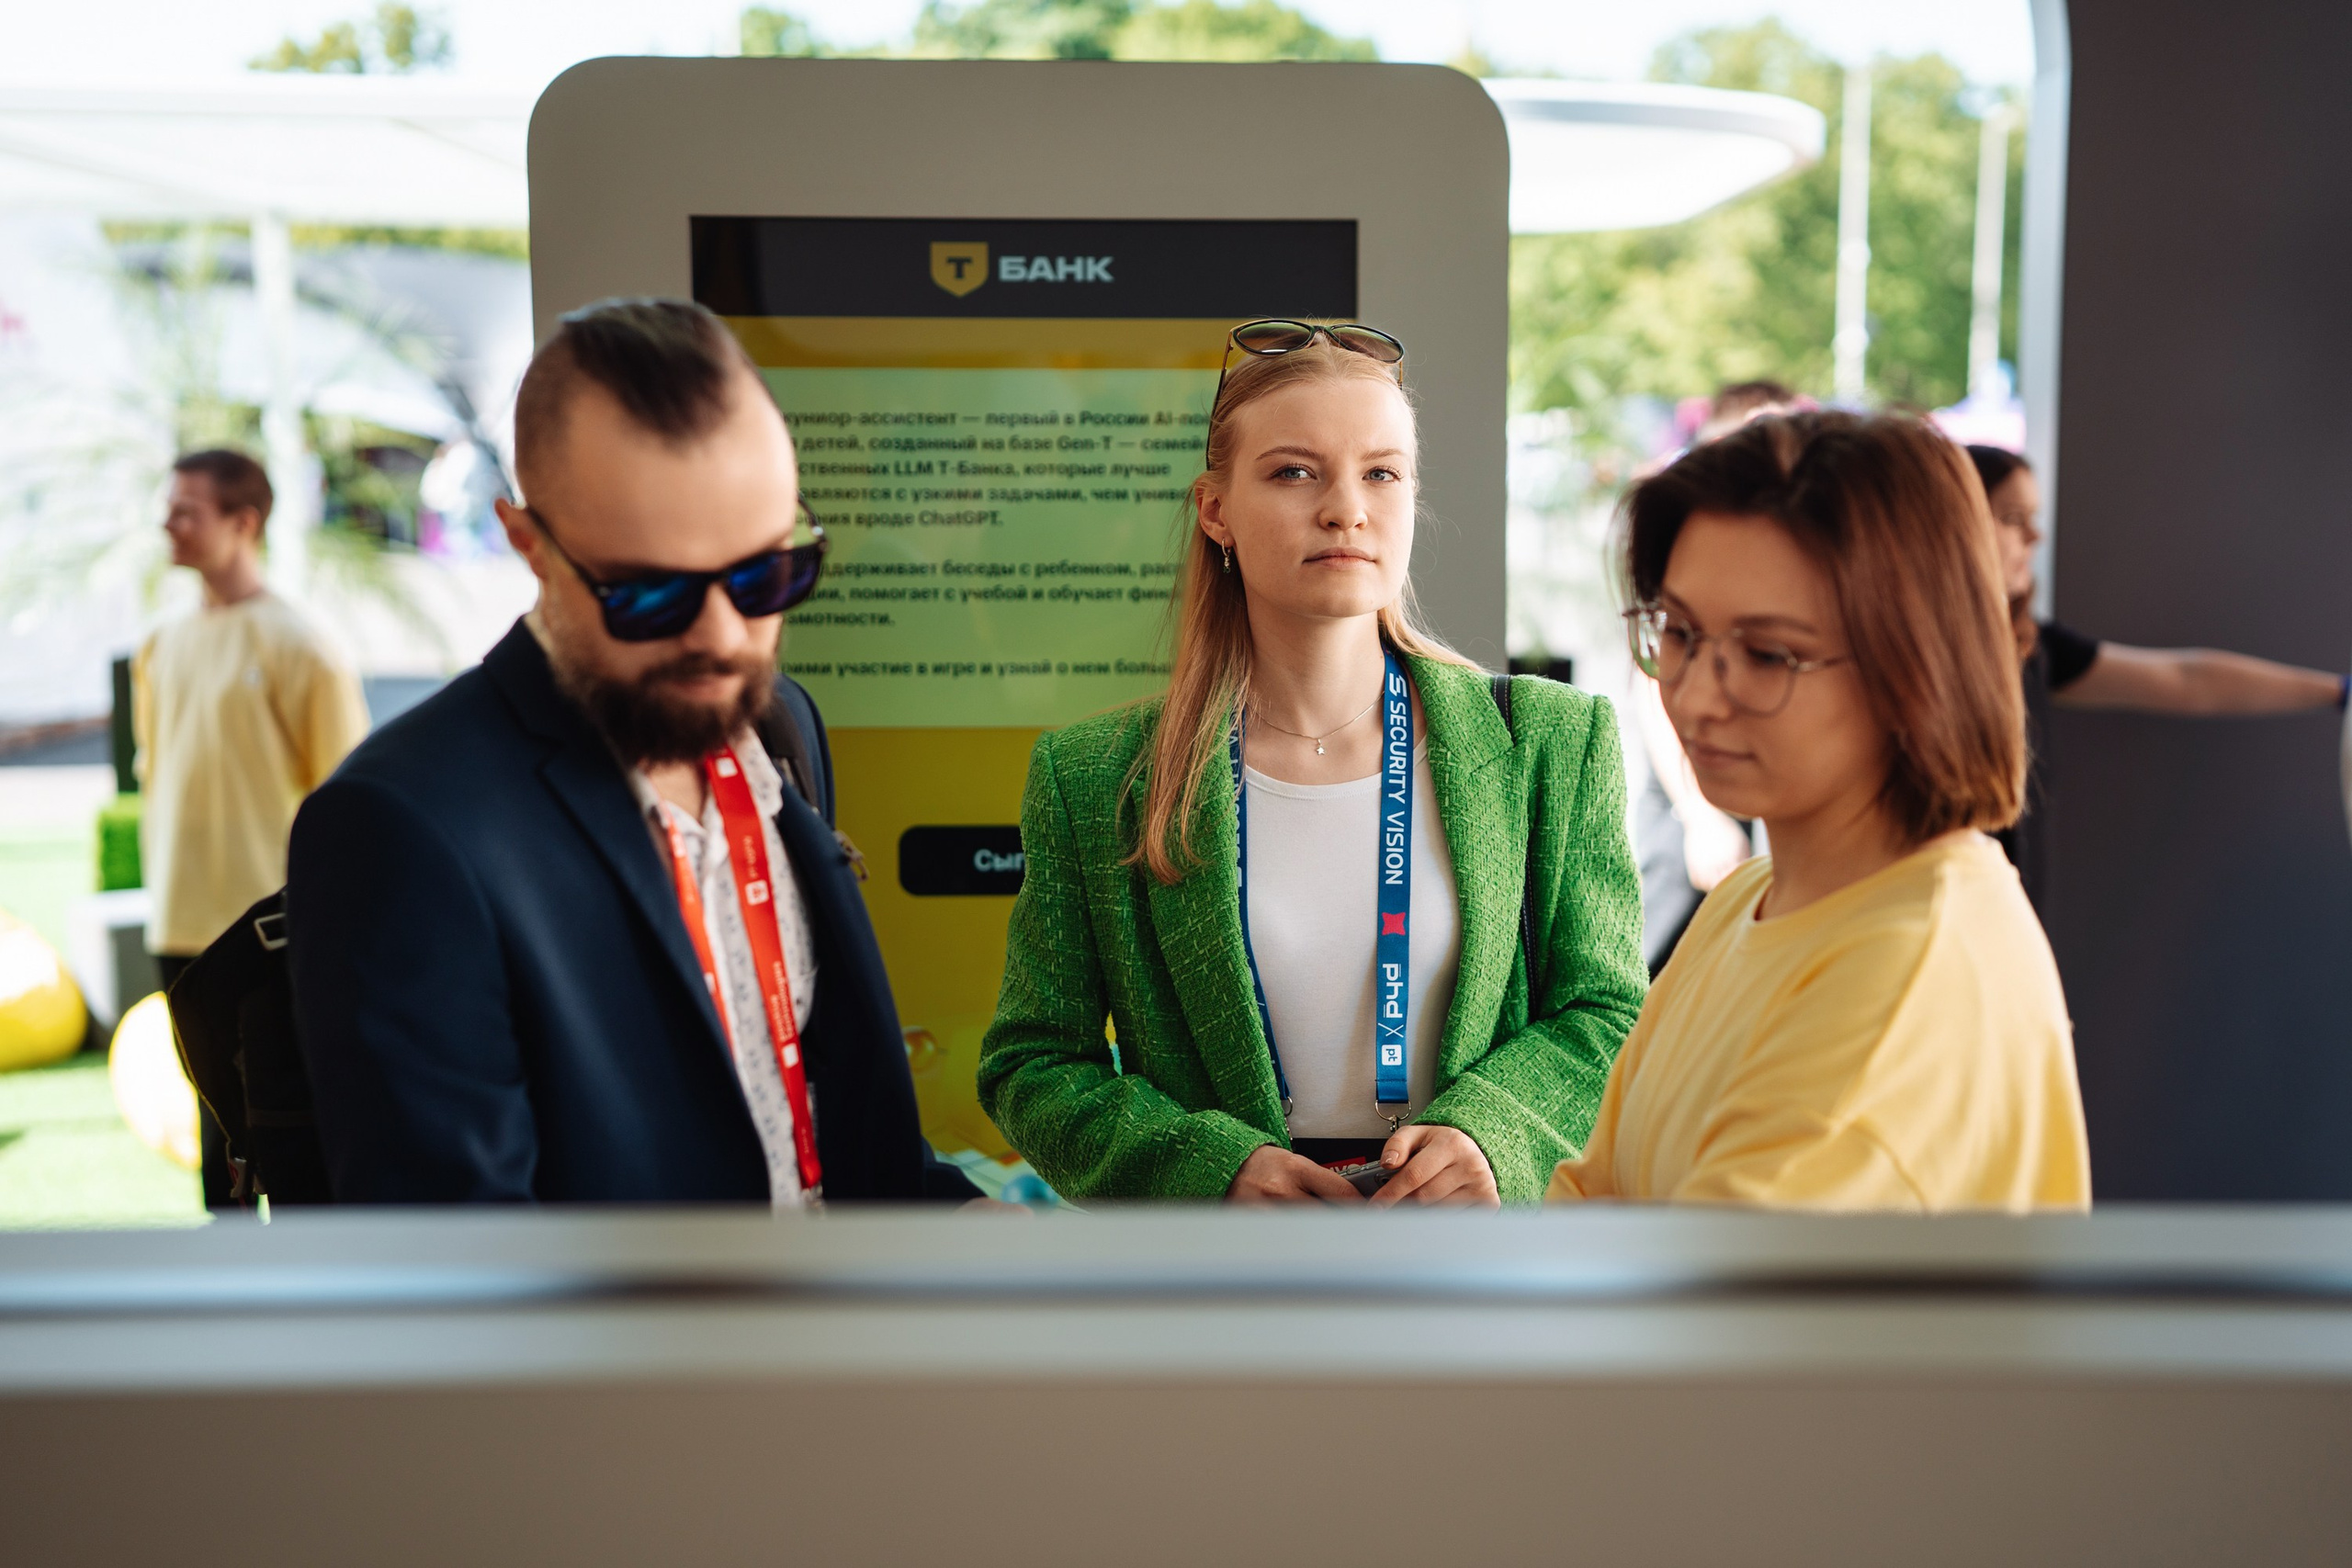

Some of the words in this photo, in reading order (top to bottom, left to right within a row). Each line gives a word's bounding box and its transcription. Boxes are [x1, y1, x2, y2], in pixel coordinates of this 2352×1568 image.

[998, 255, 1114, 282] БАНК
[985, 411, 1059, 427] первый
[1064, 414, 1075, 425] в
[1080, 411, 1149, 425] России
[1154, 411, 1210, 425] AI-по
[803, 435, 865, 451] детей,
[868, 435, 978, 451] созданный
[981, 439, 1005, 450] на
[1009, 435, 1053, 450] базе
[1141, 435, 1205, 450] семей
[797, 463, 889, 476] ственных
[894, 461, 933, 476] LLM
[1023, 464, 1106, 478] которые
[1111, 464, 1171, 478] лучше
[800, 489, 891, 501] авляются
[895, 489, 907, 501] с
[911, 489, 983, 502] узкими
[989, 489, 1088, 502] задачами,
[1091, 489, 1129, 501] чем
[854, 513, 914, 529] вроде
[918, 511, 1003, 526] ChatGPT.
[942, 558, 1016, 577] беседы
[1019, 563, 1031, 575] с
[1035, 559, 1136, 577] ребенком,
[849, 588, 940, 602] помогает
[944, 588, 956, 601] с
[960, 585, 1028, 604] учебой
[1032, 589, 1045, 601] и
[1047, 585, 1123, 604] обучает
[787, 613, 895, 626] амотности.
[836, 662, 913, 678] участие
[917, 662, 928, 675] в
[932, 662, 977, 678] игре
[980, 662, 992, 675] и
[997, 659, 1052, 677] узнай
[1056, 662, 1069, 675] о
[1071, 662, 1111, 675] нем
[1384, 701, 1408, 803] SECURITY
[1385, 810, 1405, 885] VISION
[1382, 963, 1404, 1019] phd
